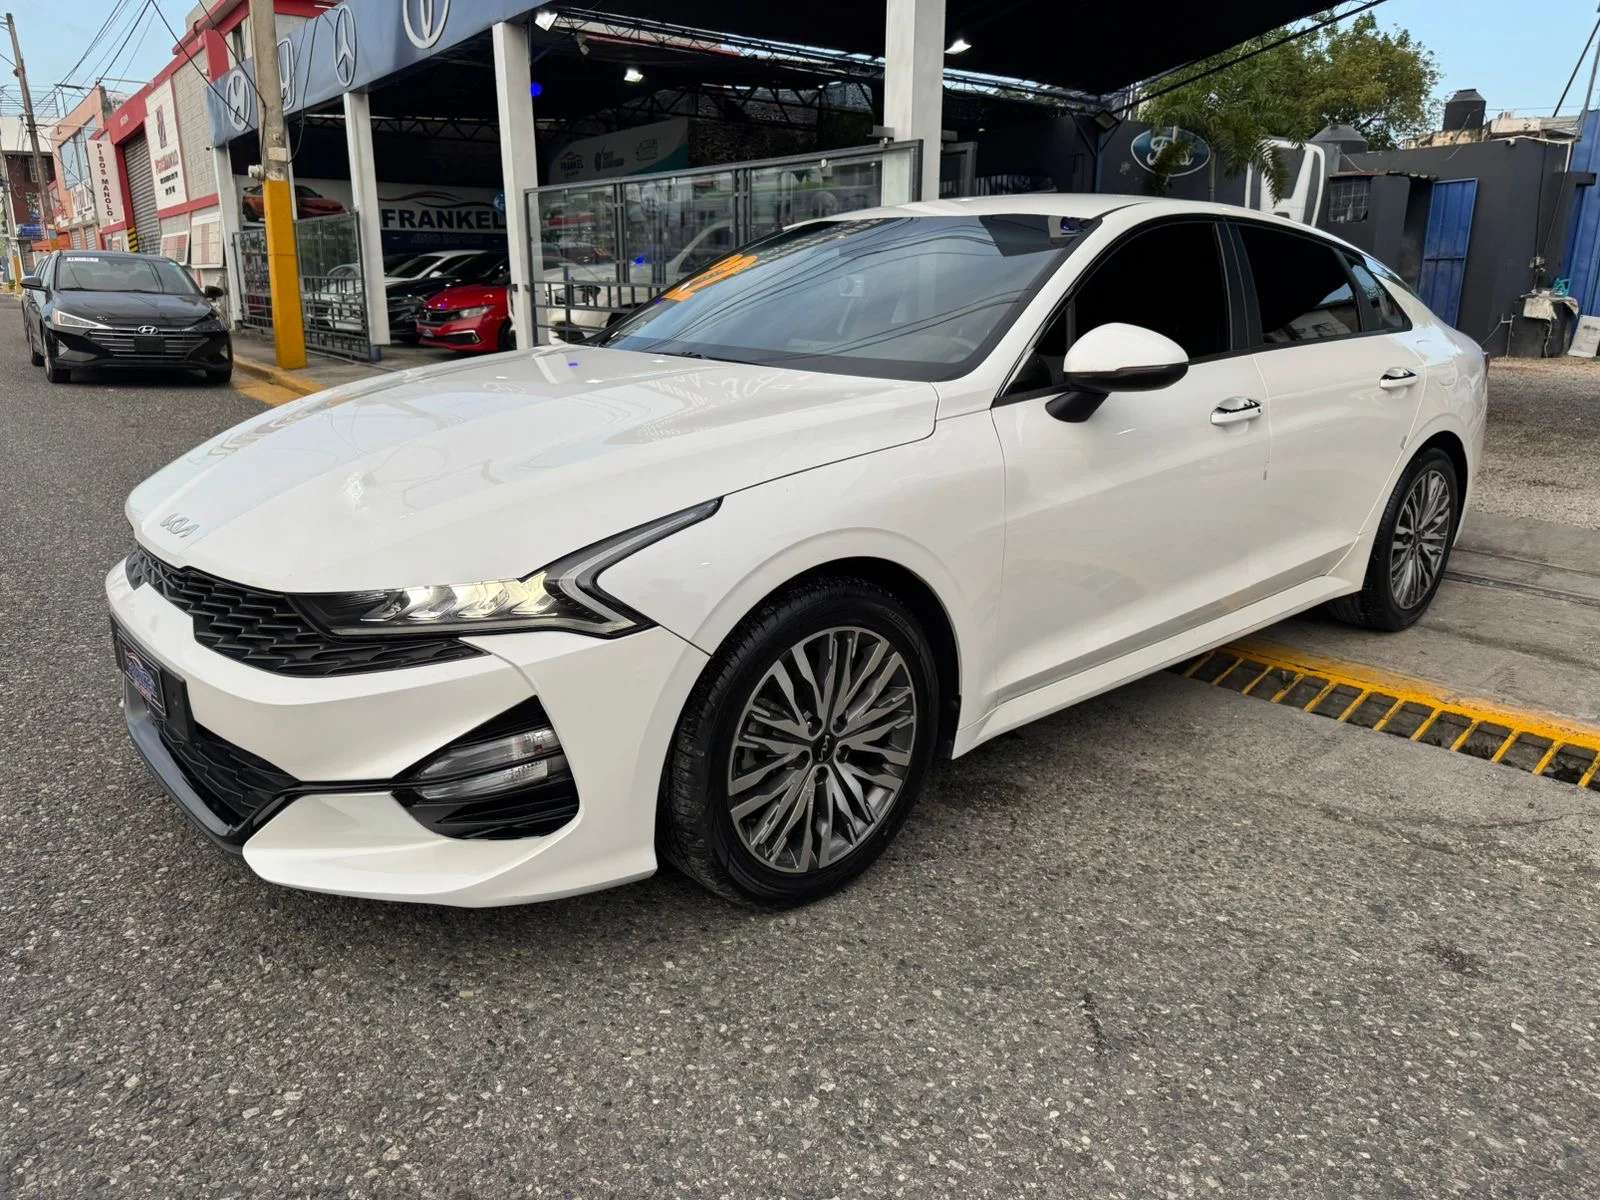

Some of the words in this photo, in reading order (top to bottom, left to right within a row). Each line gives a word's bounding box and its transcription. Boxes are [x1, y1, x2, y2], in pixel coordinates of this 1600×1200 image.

[97, 143, 107, 175] PISOS
[102, 178, 113, 216] MANOLO
[381, 208, 507, 230] FRANKEL
